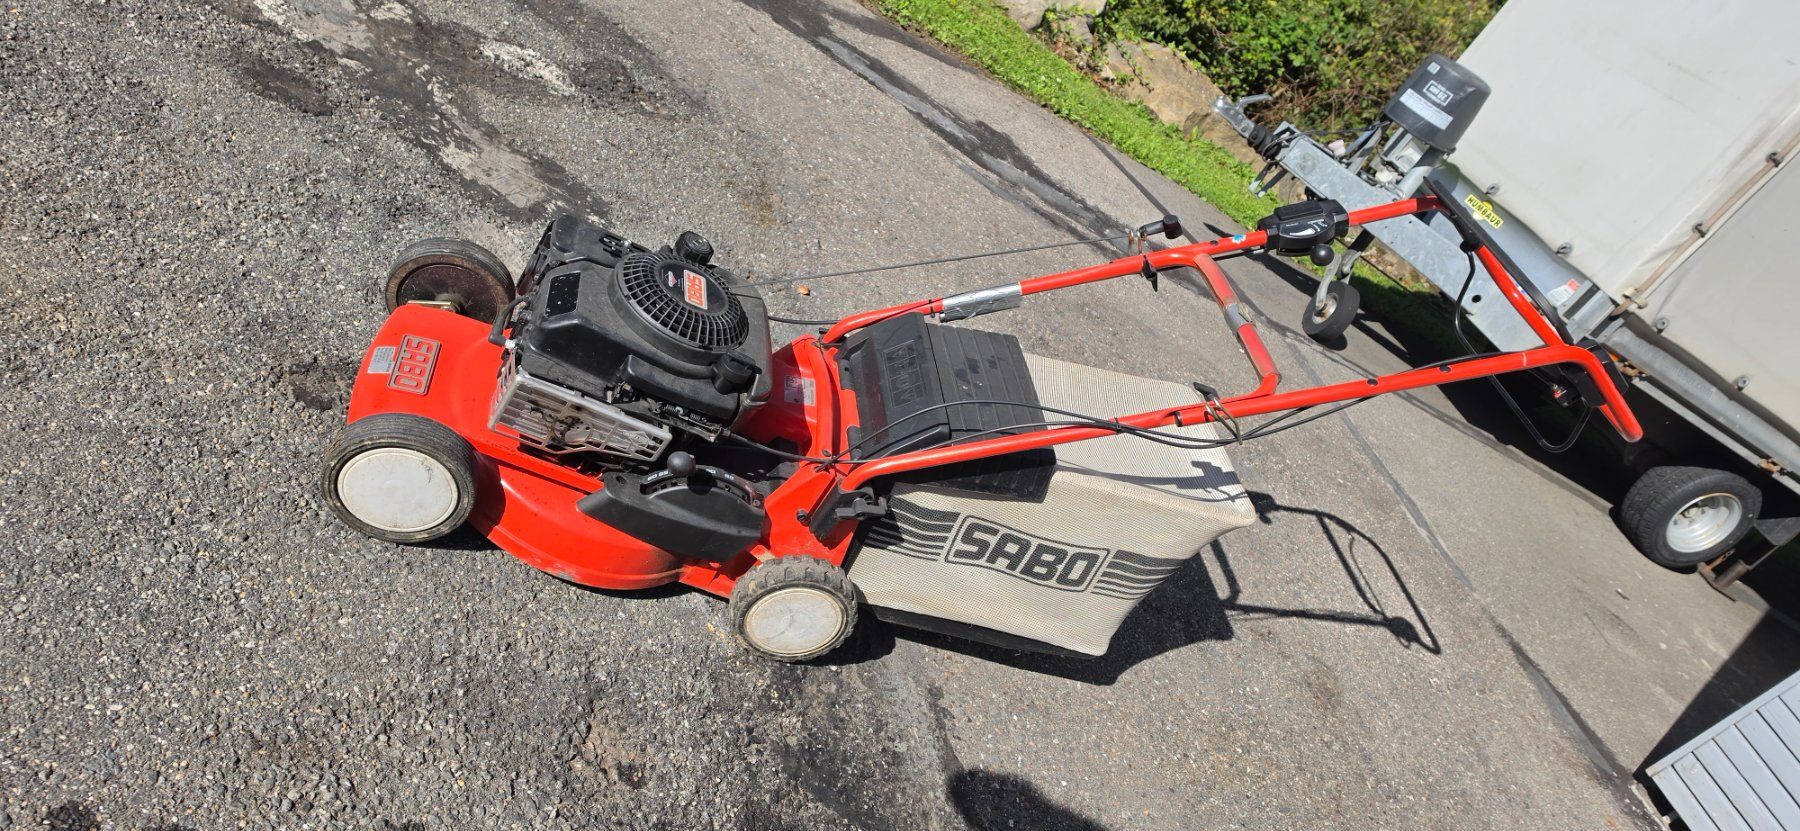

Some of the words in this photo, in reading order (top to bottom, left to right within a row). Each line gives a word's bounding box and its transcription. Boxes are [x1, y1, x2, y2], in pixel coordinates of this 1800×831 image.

[1467, 197, 1501, 227] HUMBAUR
[687, 273, 704, 307] SABO
[394, 338, 434, 389] SABO
[953, 522, 1101, 588] SABO
